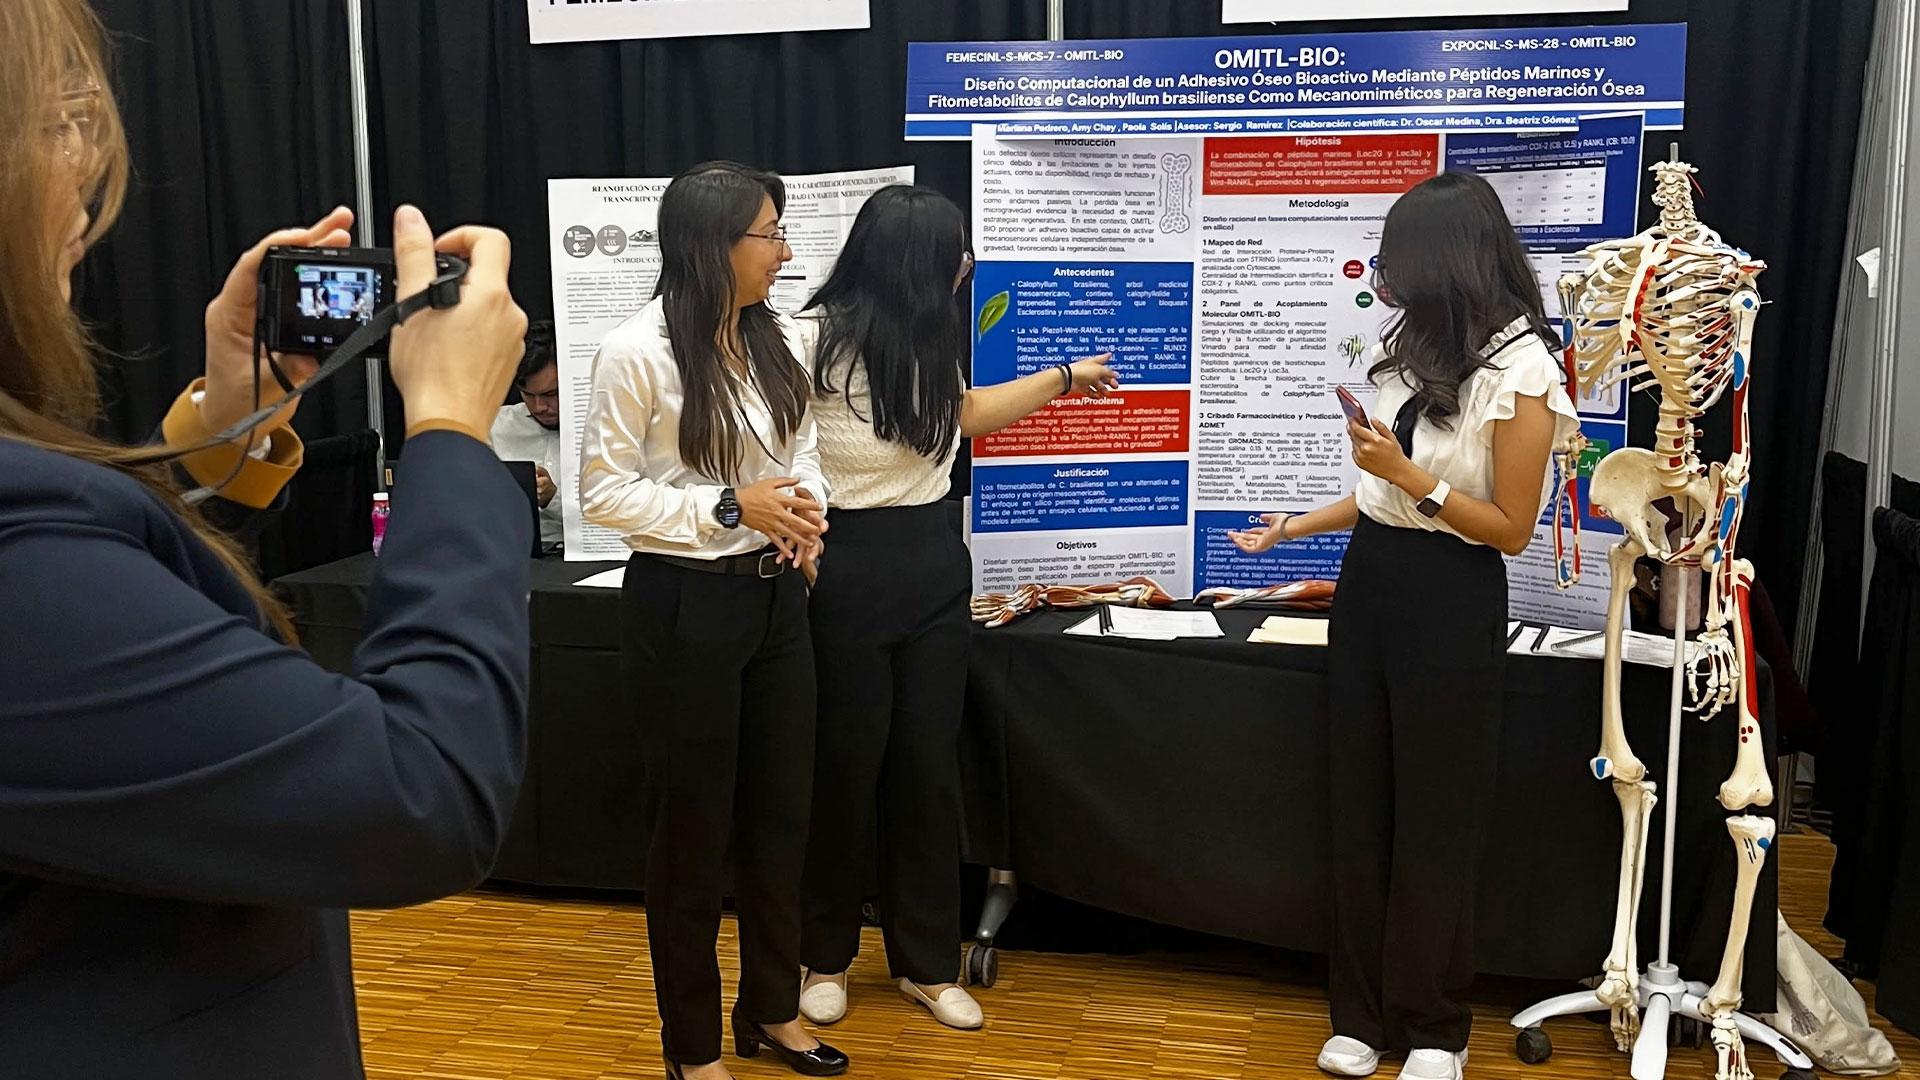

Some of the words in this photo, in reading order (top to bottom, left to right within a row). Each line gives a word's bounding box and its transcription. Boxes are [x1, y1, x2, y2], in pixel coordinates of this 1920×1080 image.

[1442, 38, 1559, 51] EXPOCNL-S-MS-28
[1569, 36, 1635, 48] OMITL-BIO
[1064, 50, 1123, 61] OMITL-BIO
[1215, 46, 1345, 69] OMITL-BIO:
[964, 77, 1014, 91] Diseño
[1017, 75, 1129, 93] Computacional
[1132, 75, 1151, 88] de
[1155, 78, 1174, 88] un
[1177, 73, 1248, 87] Adhesivo
[1252, 69, 1292, 86] Óseo
[1295, 70, 1368, 85] Bioactivo
[1372, 68, 1446, 83] Mediante
[1449, 67, 1520, 84] Péptidos
[1524, 66, 1590, 80] Marinos
[1594, 69, 1604, 82] y
[928, 93, 1041, 108] Fitometabolitos
[1044, 93, 1063, 106] de
[1067, 91, 1159, 109] Calophyllum
[1162, 90, 1245, 104] brasiliense
[1248, 89, 1294, 103] Como
[1297, 86, 1442, 102] Mecanomiméticos
[1446, 88, 1482, 102] para
[1485, 84, 1597, 101] Regeneración
[1602, 80, 1644, 97] Ósea
[1295, 137, 1341, 147] Hipótesis
[1289, 199, 1348, 210] Metodología
[1053, 268, 1114, 276] Antecedentes
[1053, 468, 1109, 477] Justificación
[1056, 540, 1096, 552] Objetivos
